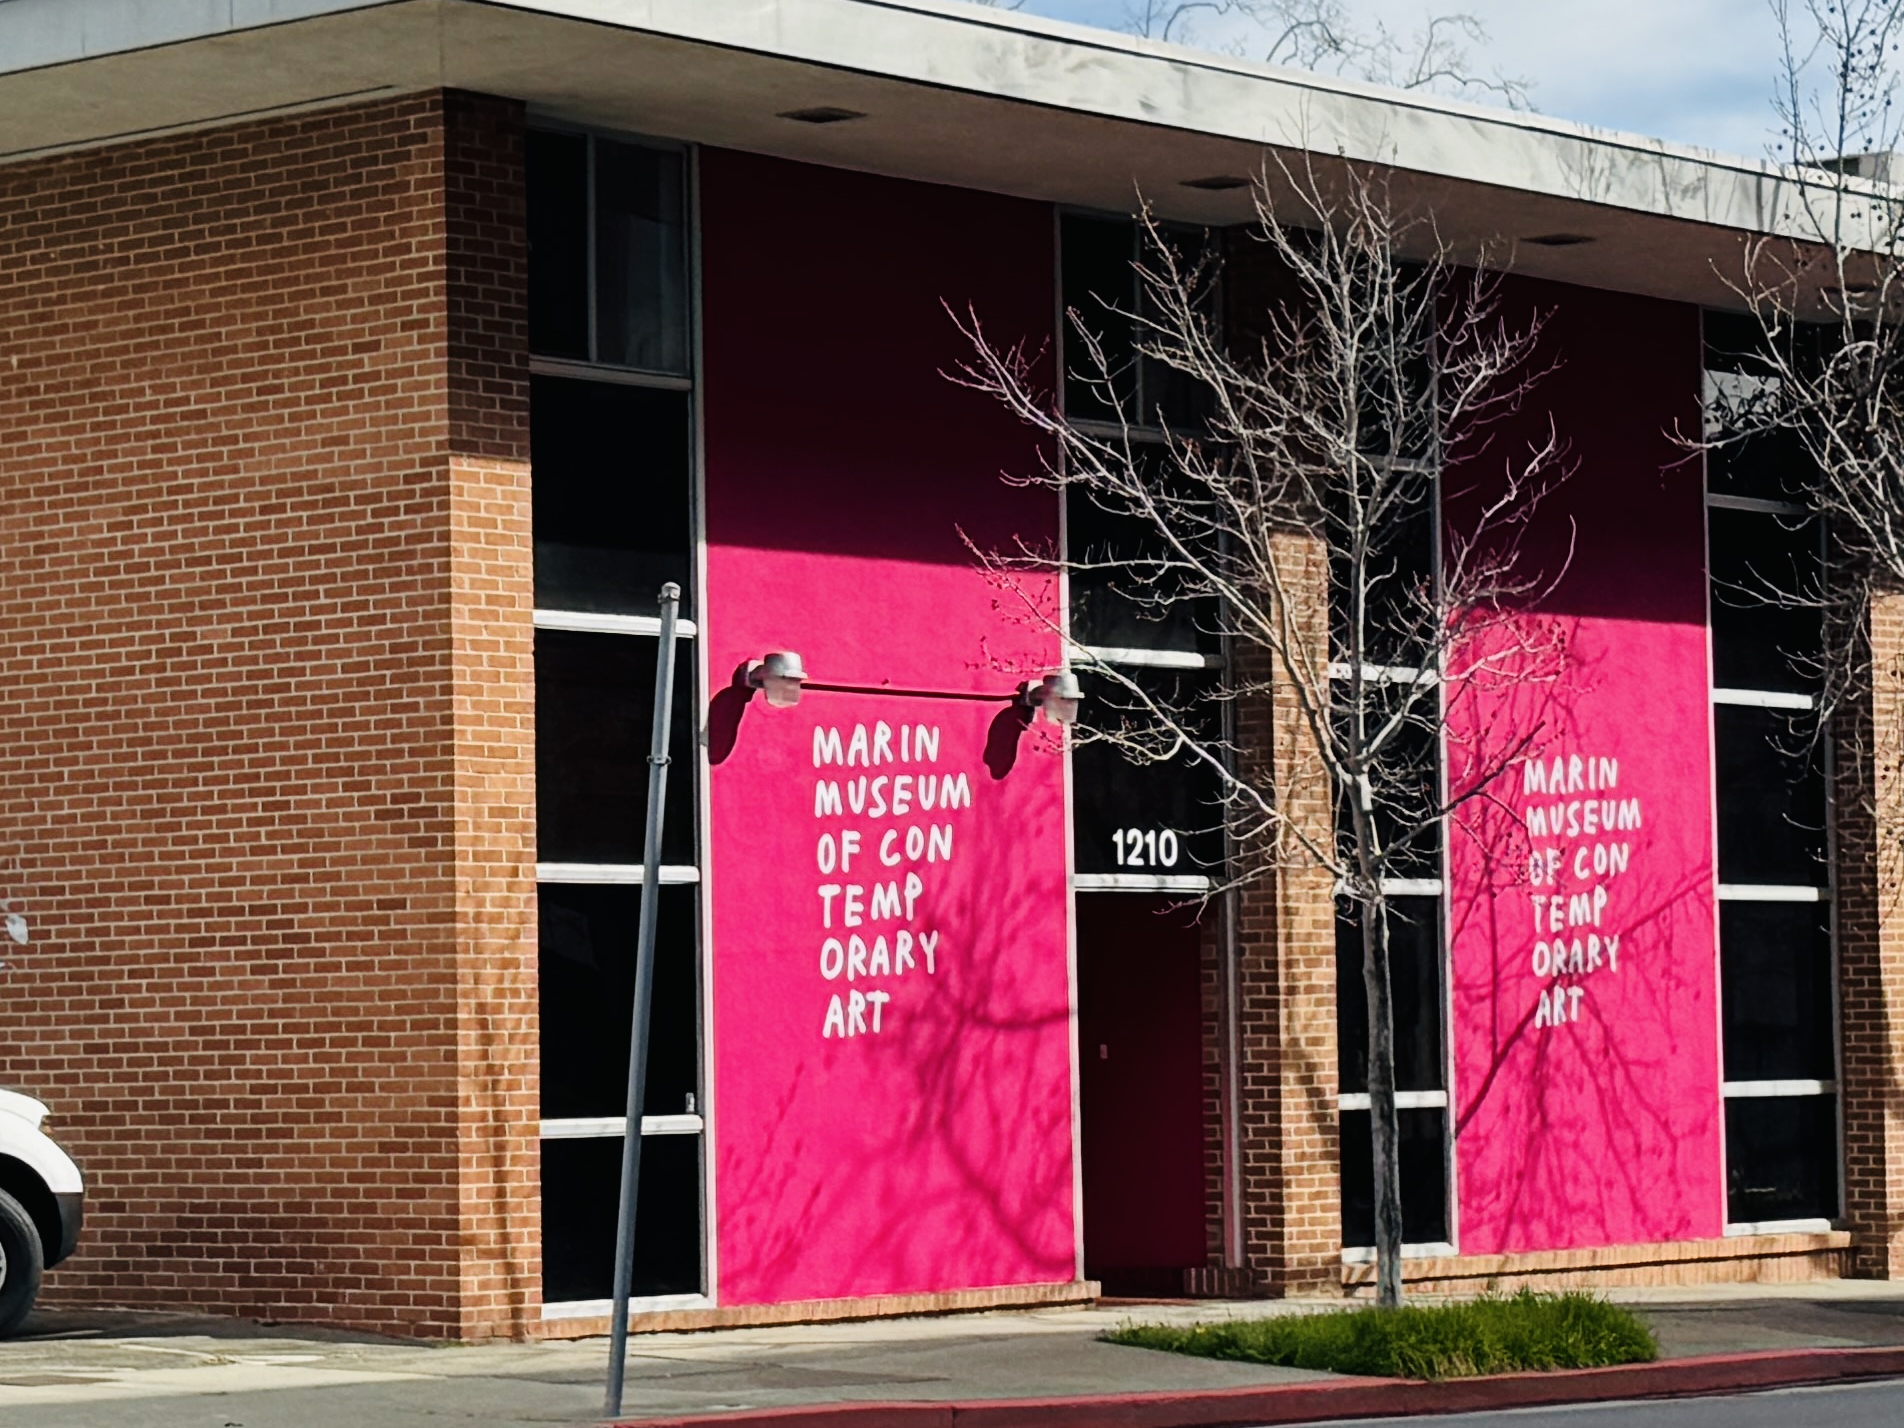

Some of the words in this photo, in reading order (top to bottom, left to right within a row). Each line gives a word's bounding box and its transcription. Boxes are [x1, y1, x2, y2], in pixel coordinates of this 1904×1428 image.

[812, 721, 940, 768] MARIN
[814, 772, 971, 818] MUSEUM
[1523, 753, 1618, 796] MARIN
[1526, 797, 1642, 838] MUSEUM
[817, 829, 861, 875] OF
[879, 824, 953, 867] CON
[1112, 828, 1179, 866] 1210
[1529, 847, 1562, 887] OF
[1573, 842, 1629, 880] CON
[817, 873, 923, 929] TEMP
[1530, 885, 1608, 933] TEMP
[819, 929, 939, 982] ORARY
[1532, 934, 1619, 978] ORARY
[822, 989, 890, 1039] ART
[1534, 985, 1584, 1029] ART
